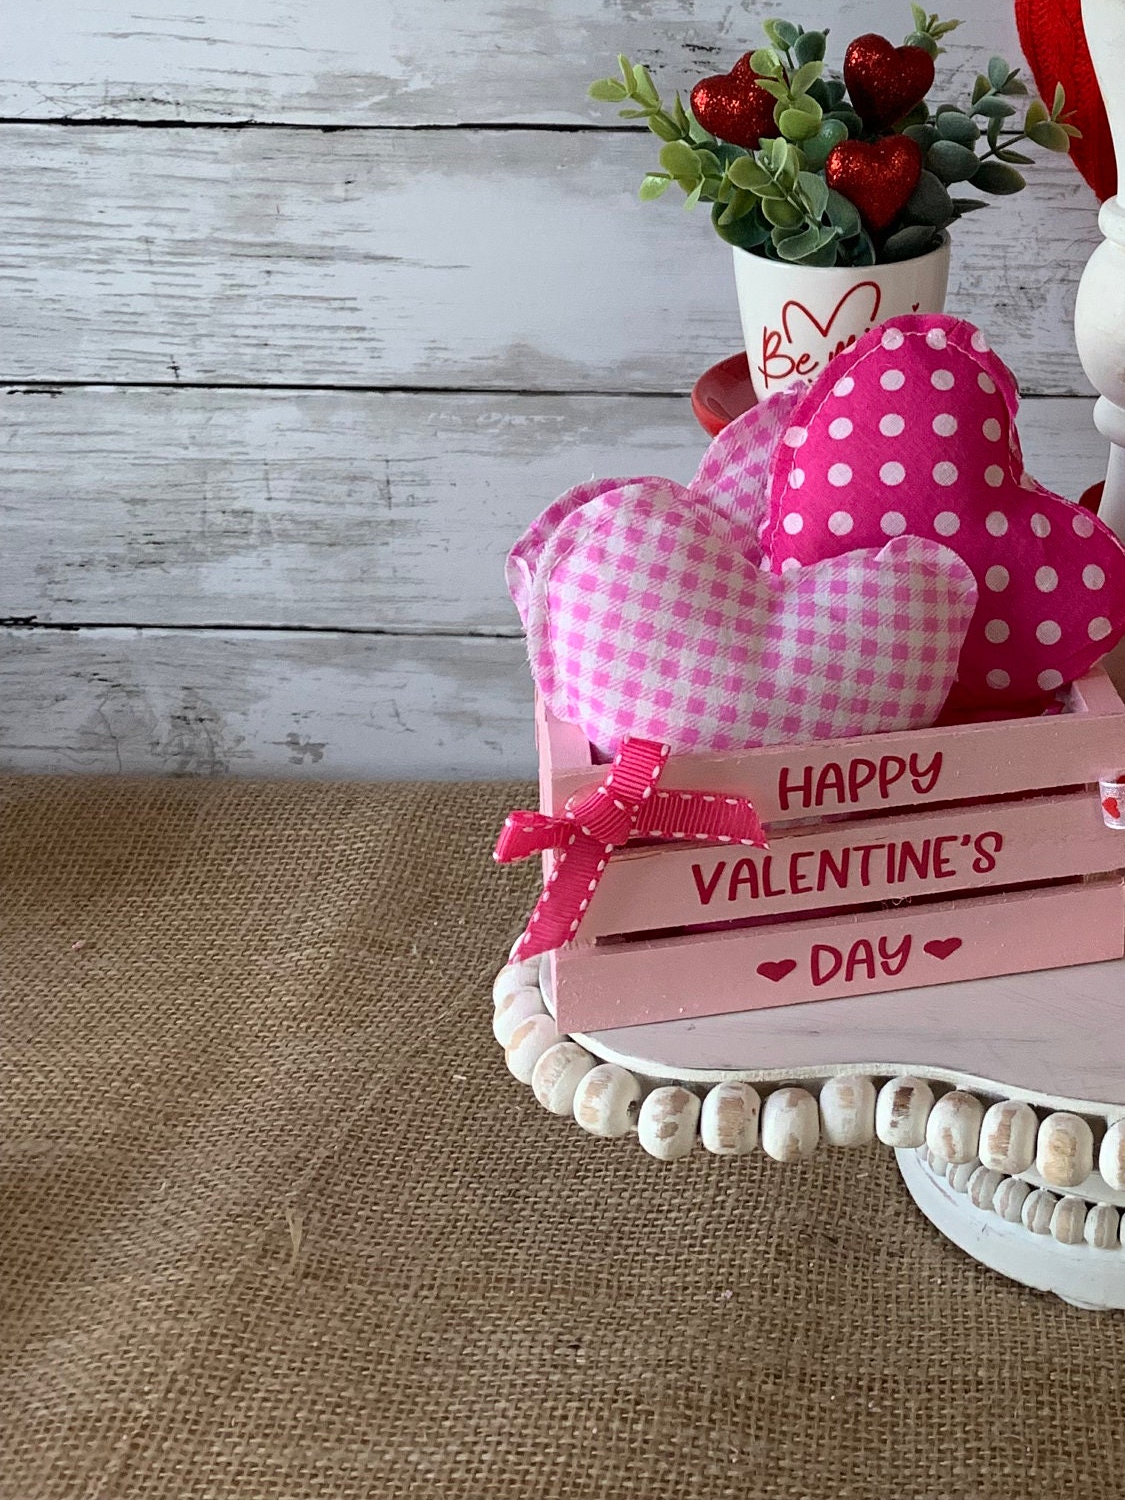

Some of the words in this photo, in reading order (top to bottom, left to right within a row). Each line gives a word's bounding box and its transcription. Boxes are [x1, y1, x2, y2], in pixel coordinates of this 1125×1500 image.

[758, 326, 819, 389] Be
[778, 751, 944, 811] HAPPY
[691, 831, 1004, 905] VALENTINE'S
[810, 934, 912, 986] DAY
